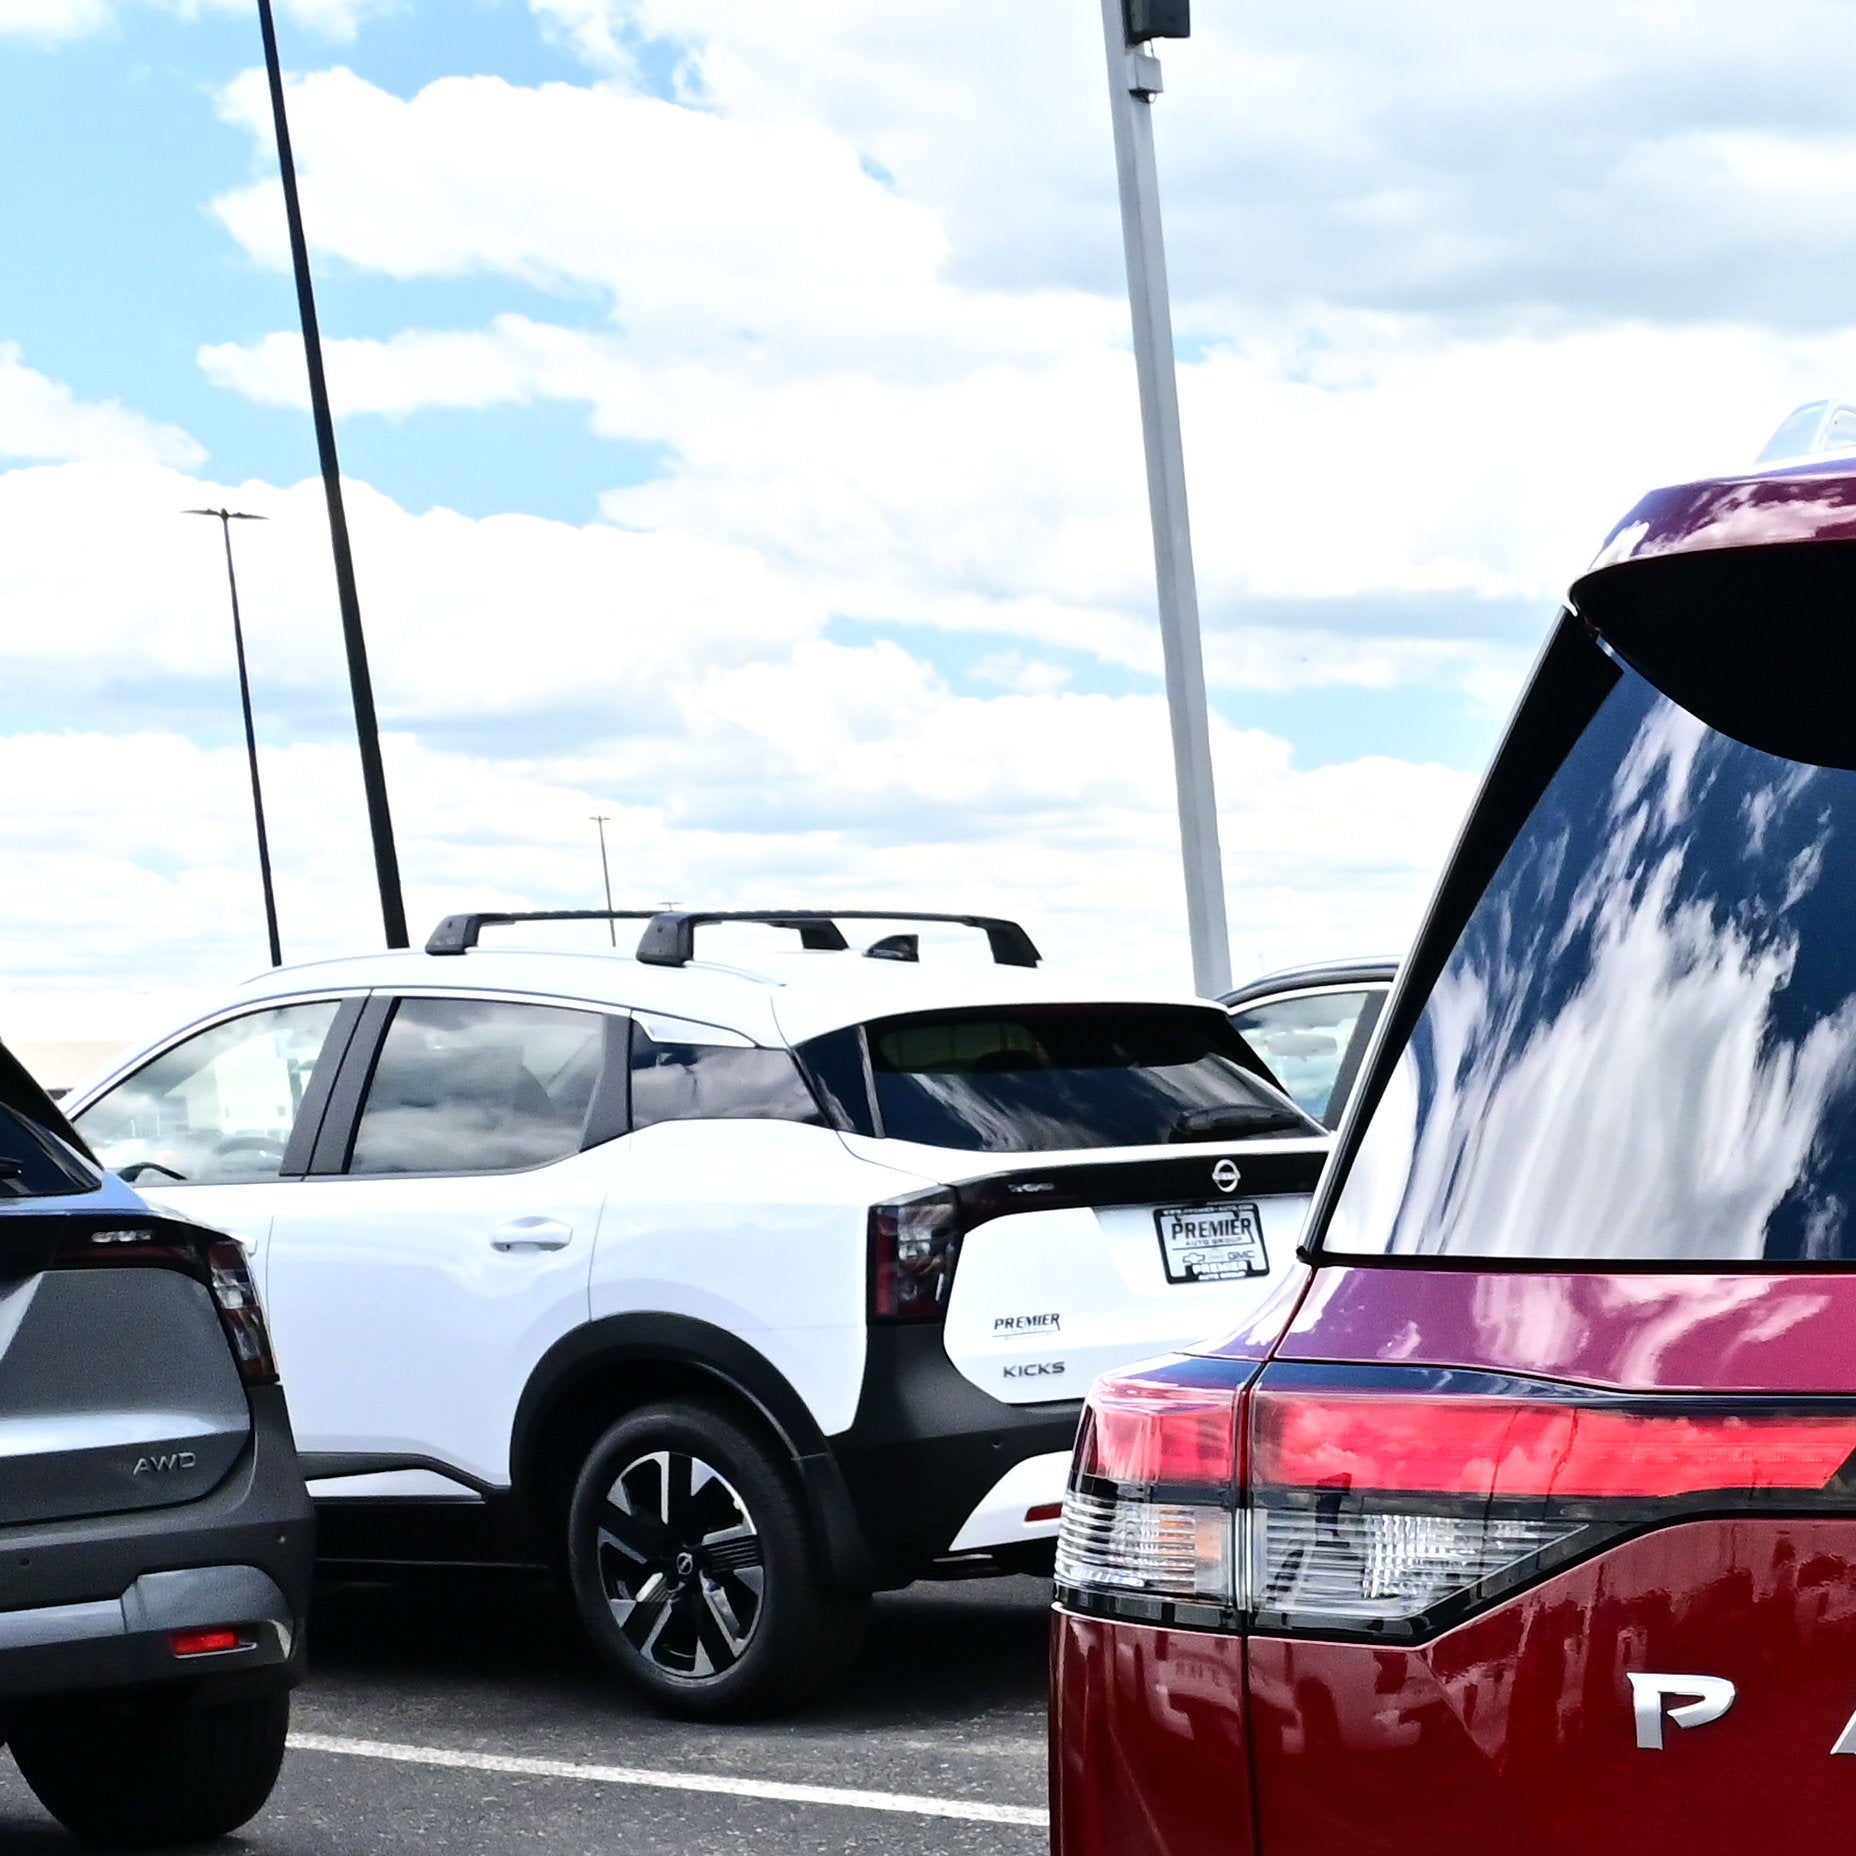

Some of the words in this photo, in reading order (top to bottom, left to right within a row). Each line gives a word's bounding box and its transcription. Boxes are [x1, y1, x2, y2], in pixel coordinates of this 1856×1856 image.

[1172, 1218, 1254, 1243] PREMIER
[1228, 1250, 1255, 1261] GMC
[994, 1313, 1060, 1331] PREMIER
[1003, 1361, 1065, 1378] KICKS
[133, 1452, 196, 1475] AWD
